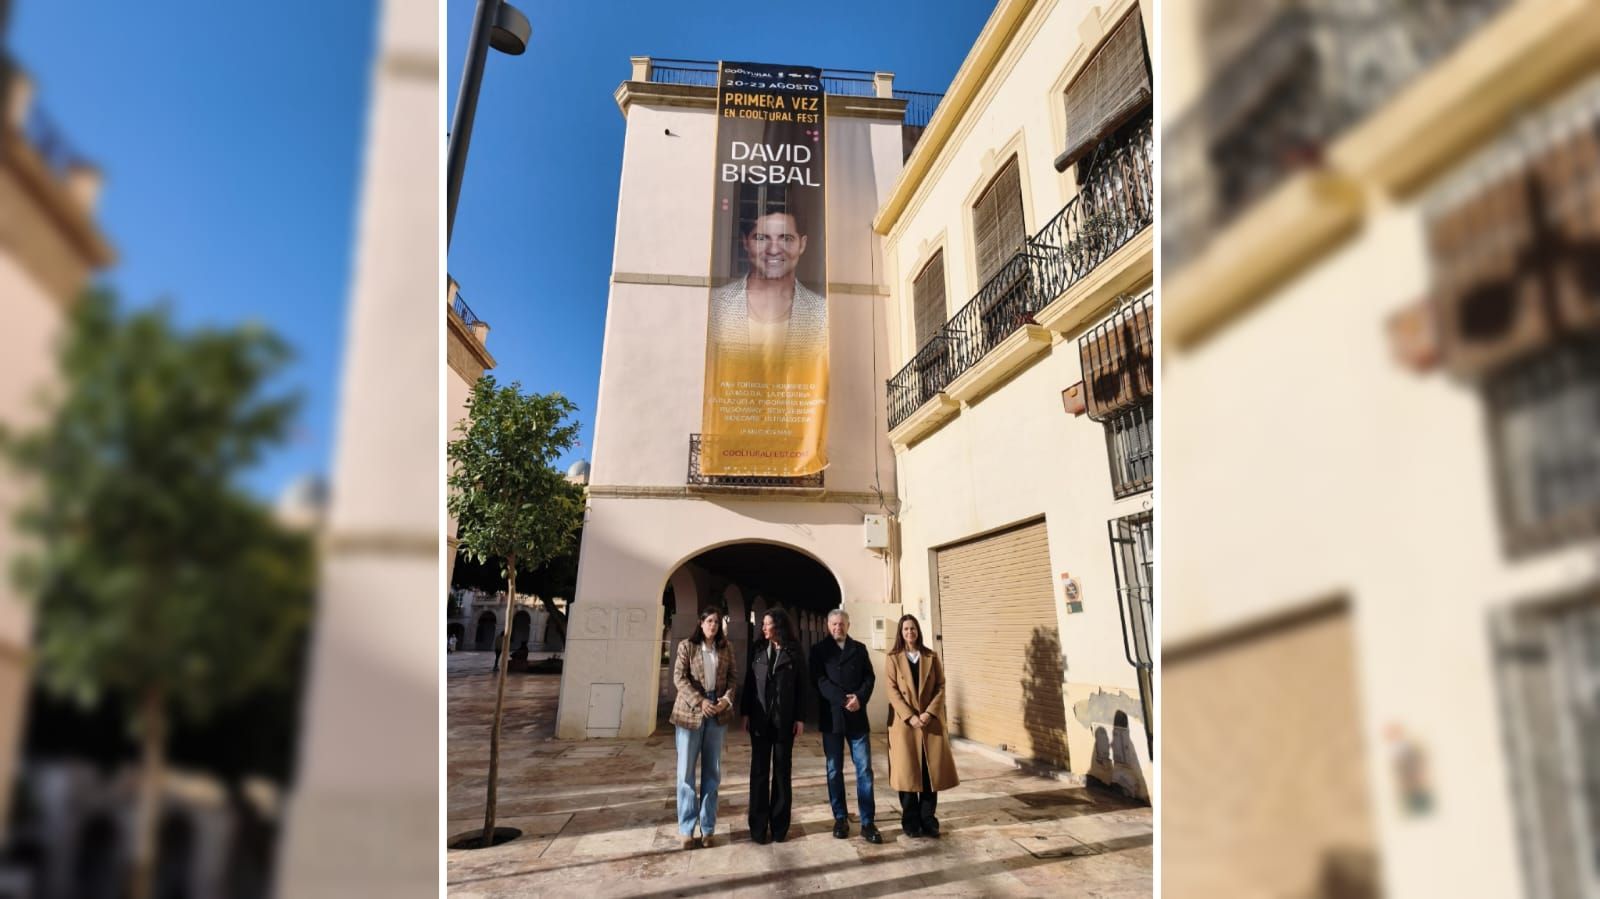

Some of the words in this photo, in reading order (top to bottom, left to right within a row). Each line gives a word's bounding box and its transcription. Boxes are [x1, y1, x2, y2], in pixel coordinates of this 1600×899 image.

[726, 80, 766, 89] 20-23
[768, 82, 819, 91] AGOSTO
[725, 93, 785, 109] PRIMERA
[791, 97, 819, 111] VEZ
[724, 109, 736, 118] EN
[739, 109, 793, 122] COOLTURAL
[797, 113, 819, 124] FEST
[731, 141, 812, 163] DAVID
[722, 163, 821, 187] BISBAL
